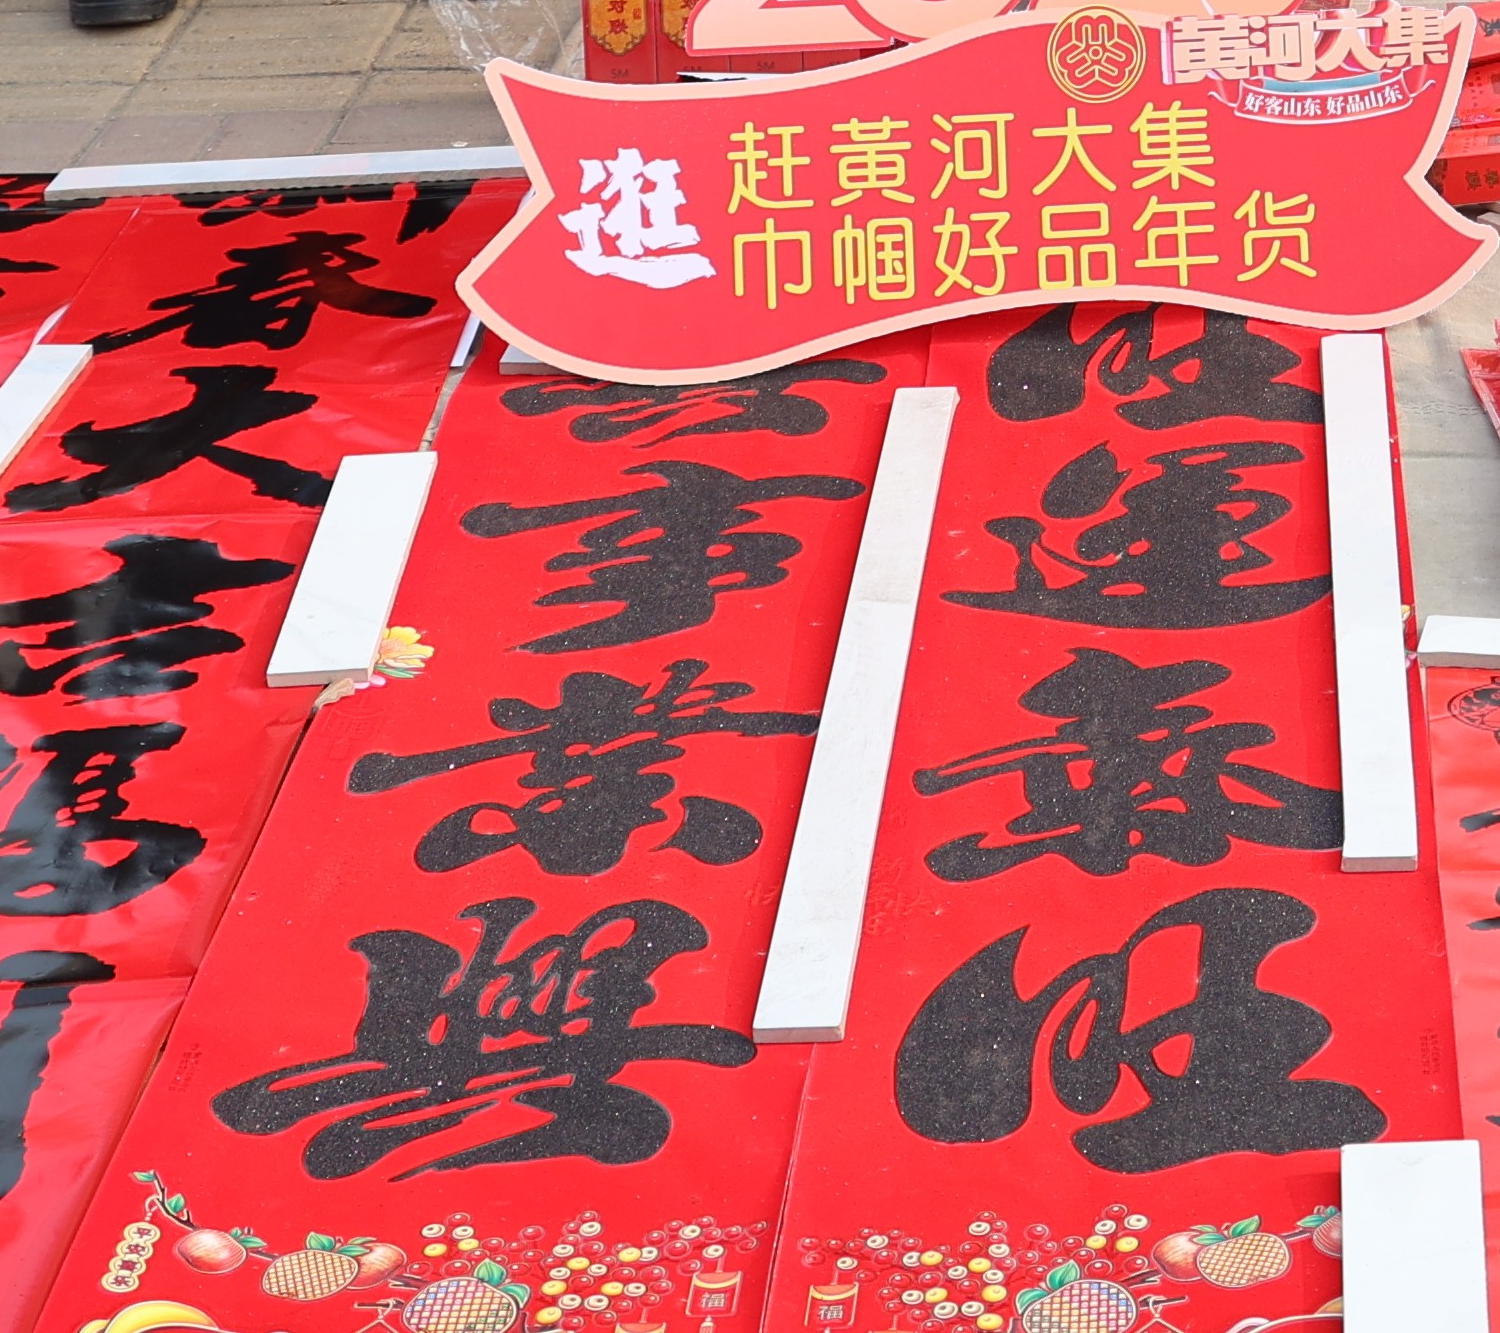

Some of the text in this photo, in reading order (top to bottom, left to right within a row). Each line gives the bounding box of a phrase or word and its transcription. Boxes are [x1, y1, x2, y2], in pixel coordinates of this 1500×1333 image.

[1170, 0, 1452, 85] 黄河大集
[726, 100, 1218, 211] 赶黄河大集
[1243, 85, 1404, 117] 好客山东 好品山东
[558, 144, 718, 290] 逛
[728, 189, 1319, 312] 巾帼好品年货
